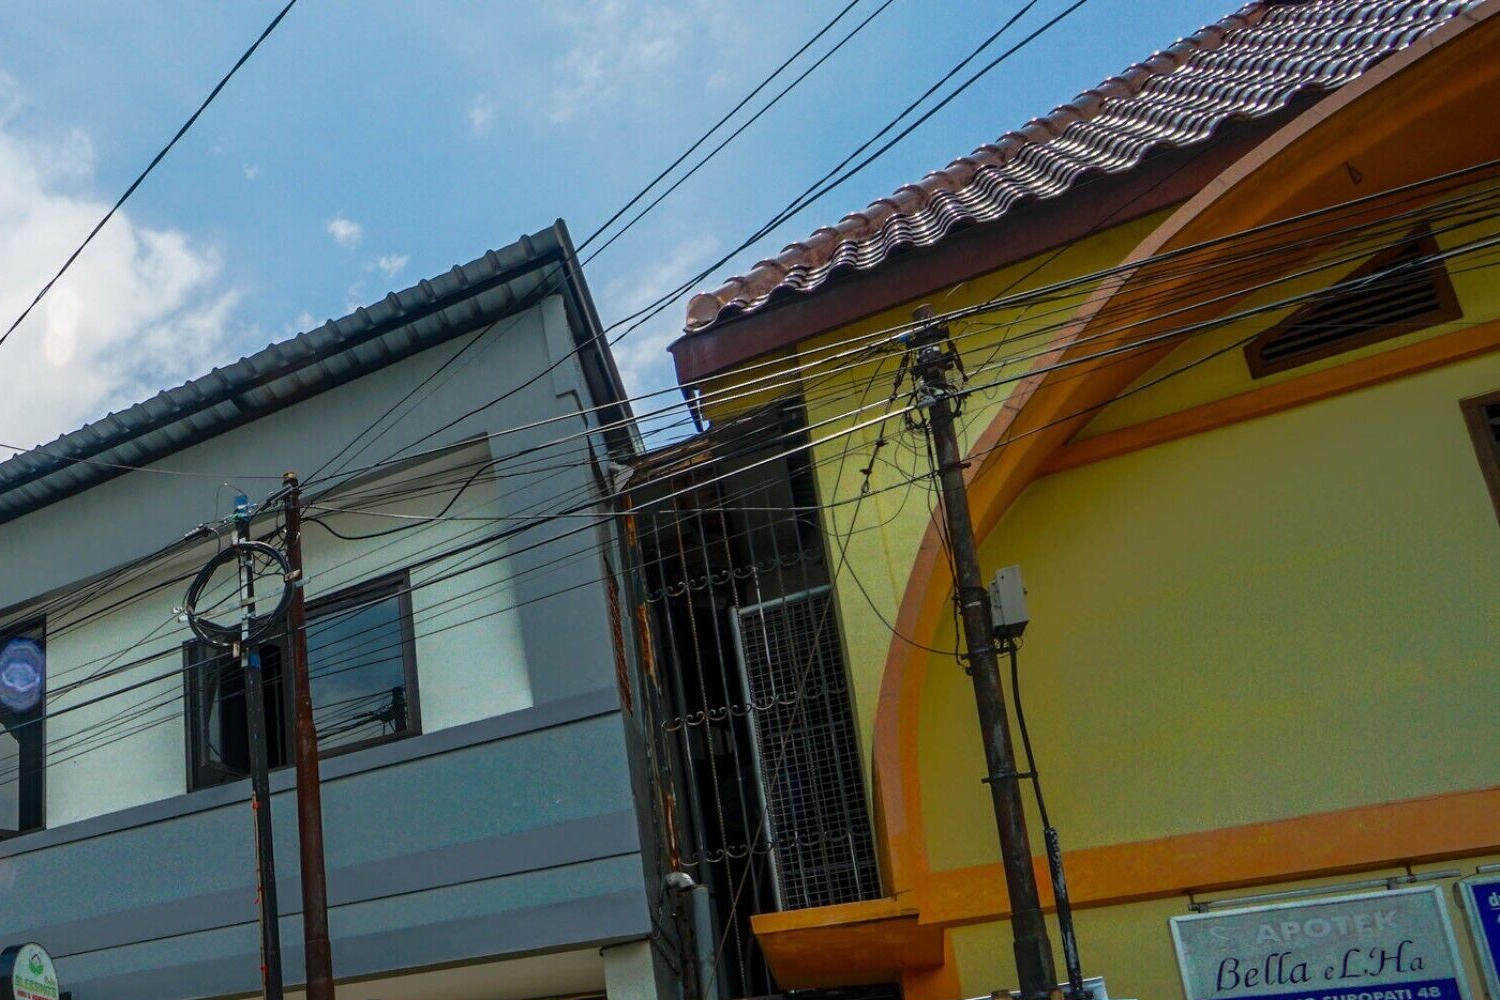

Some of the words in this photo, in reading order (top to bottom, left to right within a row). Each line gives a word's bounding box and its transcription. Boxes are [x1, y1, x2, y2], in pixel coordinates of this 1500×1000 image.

[1256, 909, 1399, 944] APOTEK
[1216, 951, 1311, 992] Bella
[1417, 986, 1441, 999] 48
